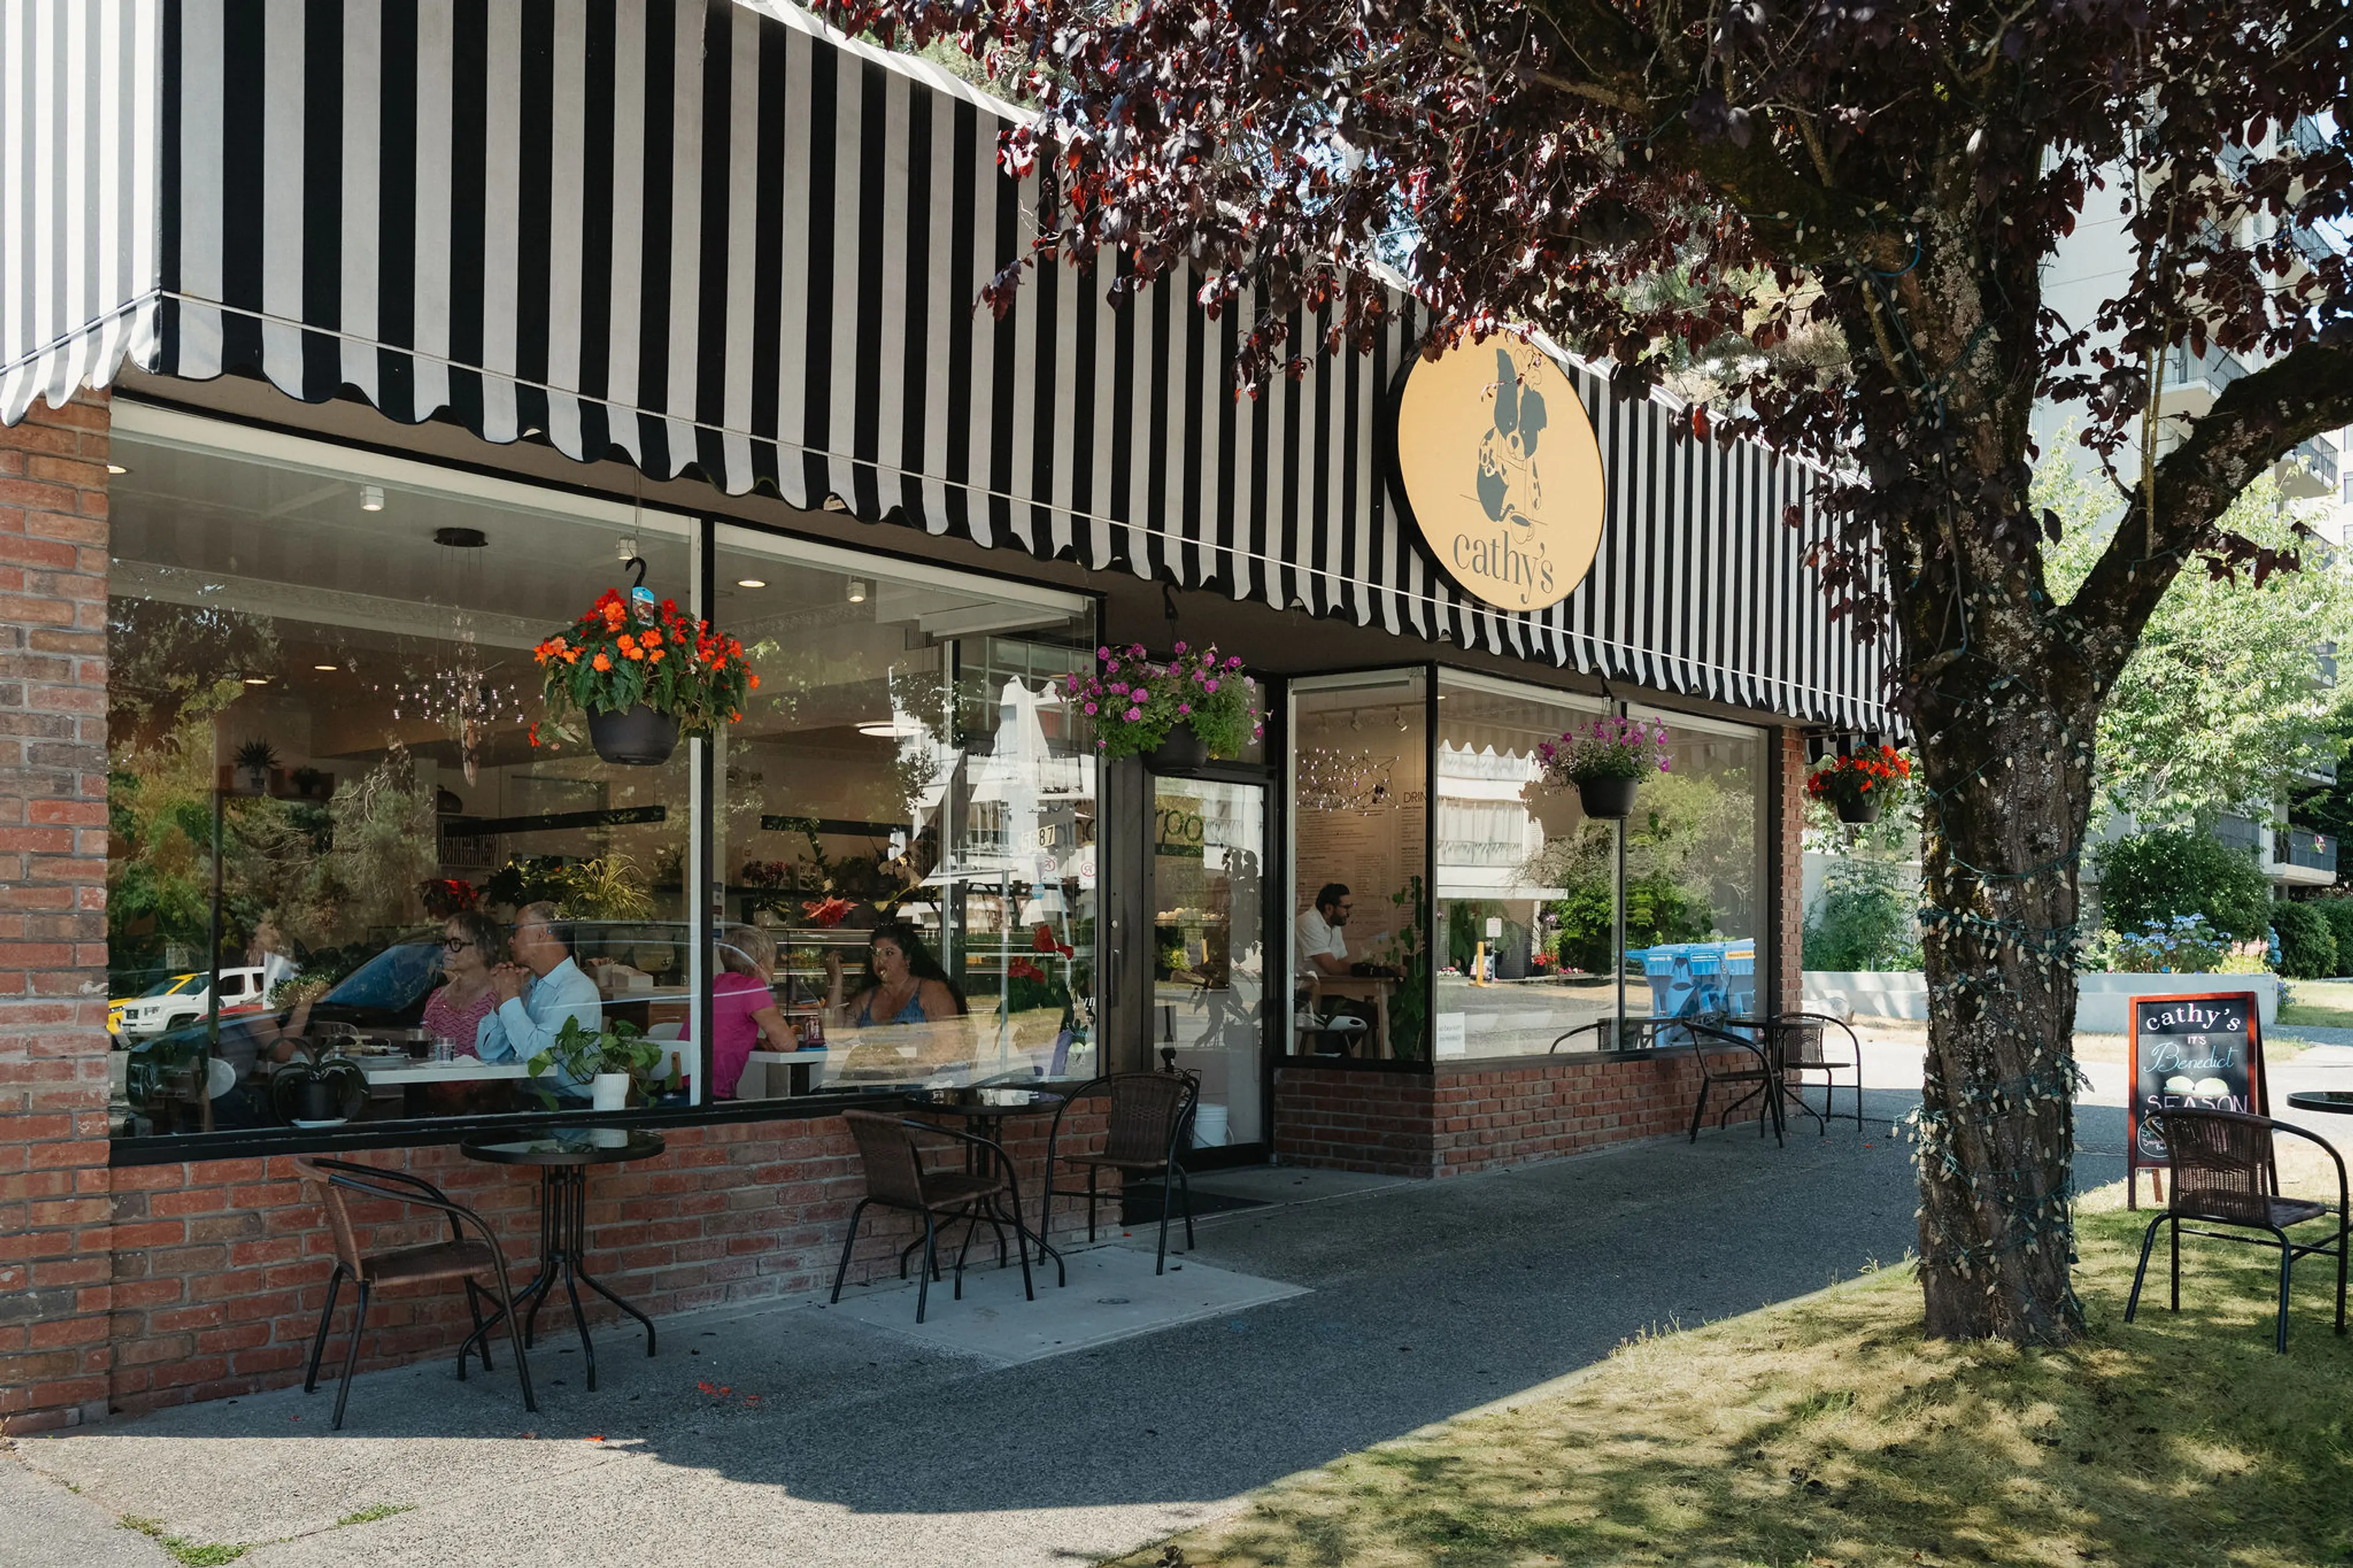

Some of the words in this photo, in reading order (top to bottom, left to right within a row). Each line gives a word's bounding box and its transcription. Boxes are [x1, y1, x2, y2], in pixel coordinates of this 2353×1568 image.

[1454, 531, 1553, 604] cathy's
[2146, 1003, 2241, 1031] cathy's
[2143, 1042, 2238, 1072] Benedict
